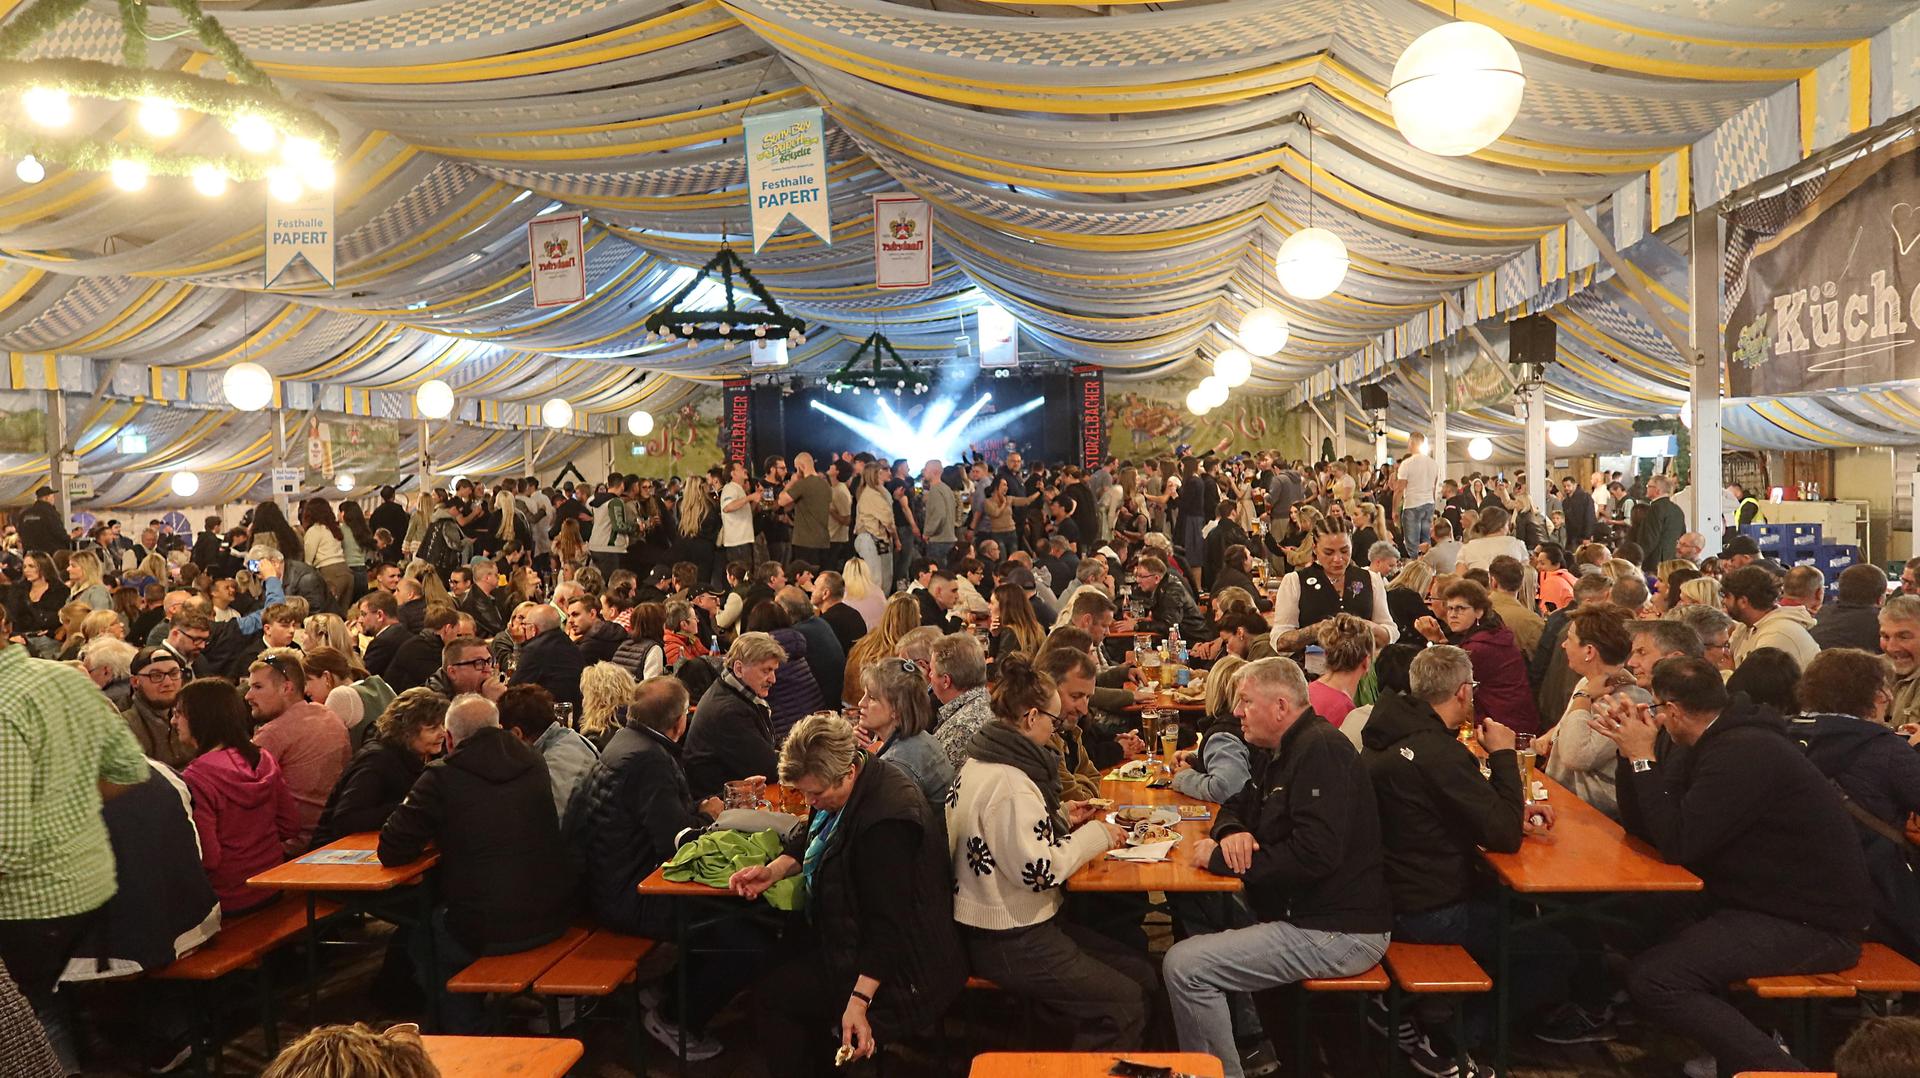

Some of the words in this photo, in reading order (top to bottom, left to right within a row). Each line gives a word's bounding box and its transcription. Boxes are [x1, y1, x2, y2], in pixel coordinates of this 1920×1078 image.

[761, 175, 814, 190] Festhalle
[758, 188, 820, 209] PAPERT
[277, 218, 324, 228] Festhalle
[273, 231, 328, 244] PAPERT
